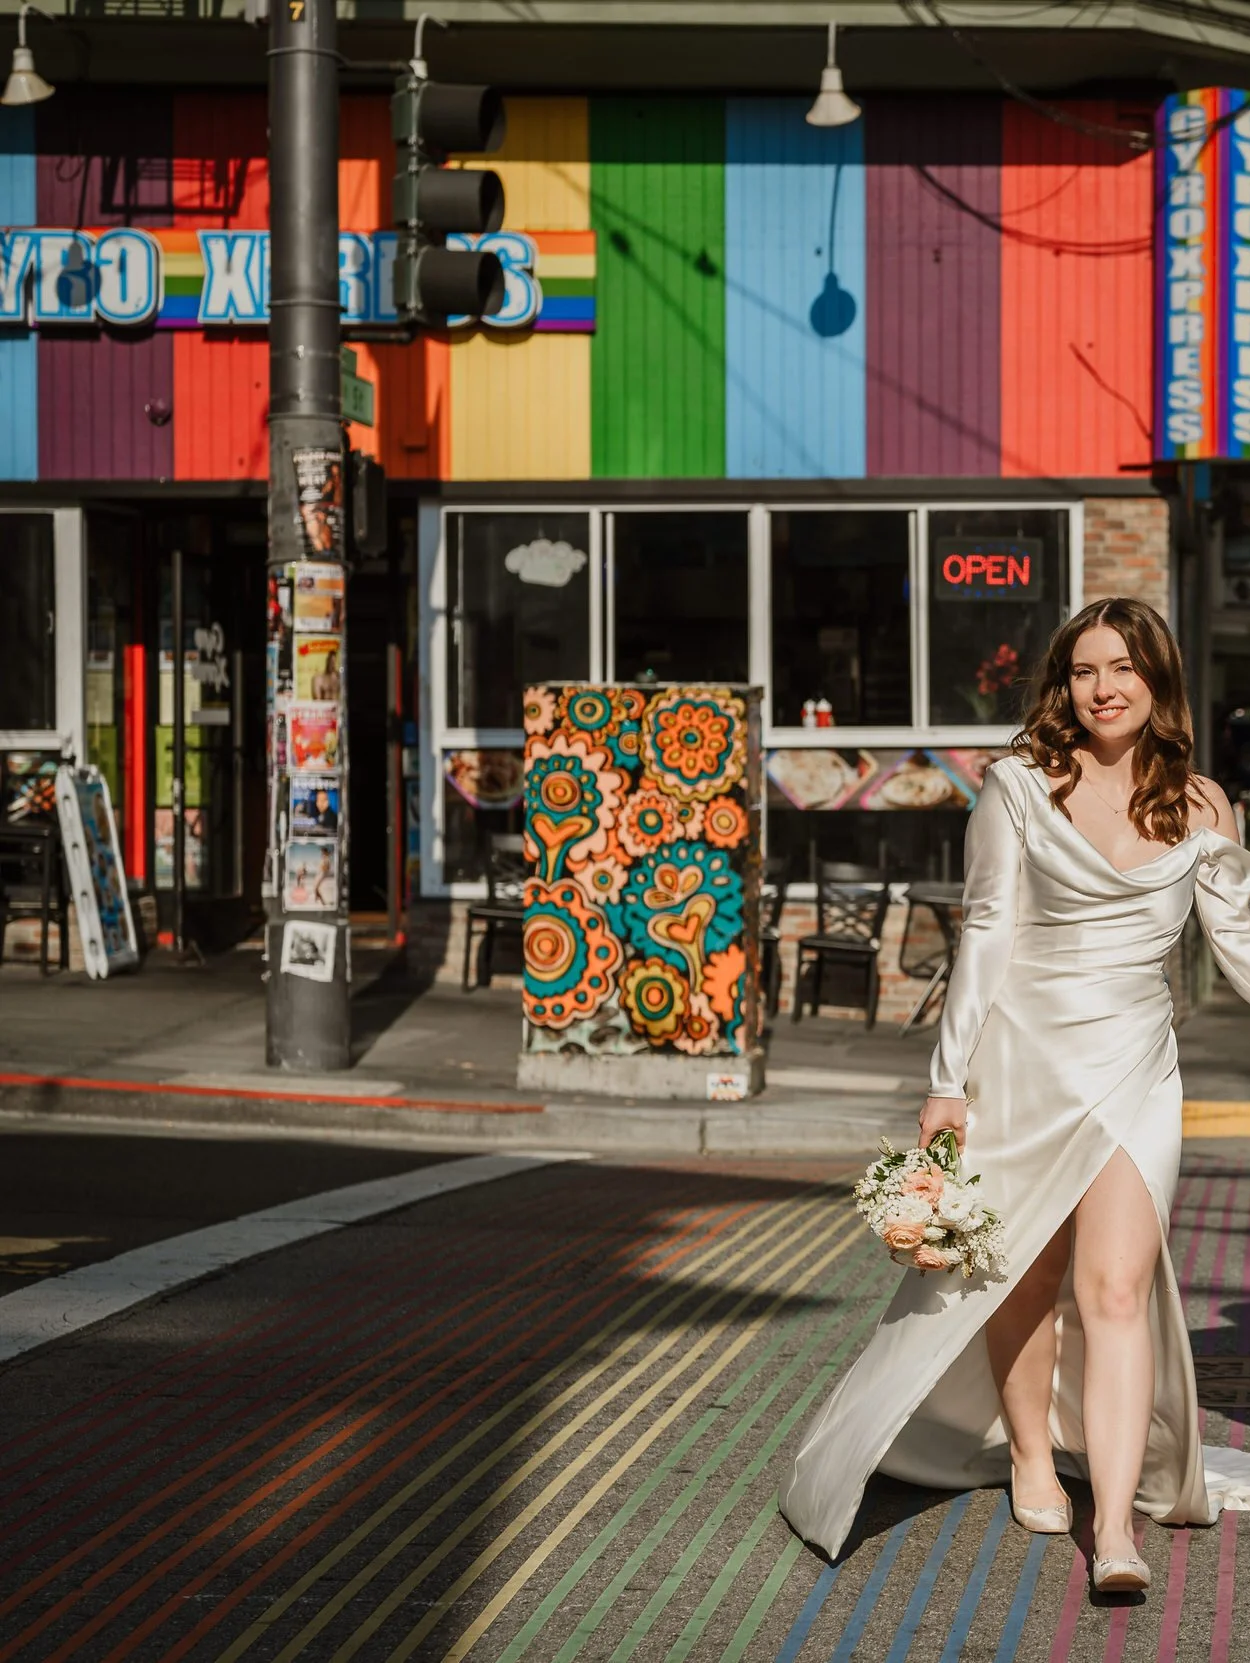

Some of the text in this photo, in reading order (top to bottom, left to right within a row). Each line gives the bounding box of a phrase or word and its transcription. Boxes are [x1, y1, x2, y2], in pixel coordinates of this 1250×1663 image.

[289, 1, 305, 21] 7
[196, 229, 542, 327] XRS
[1167, 104, 1207, 444] GYRO XPRESS
[942, 553, 1031, 586] OPEN
